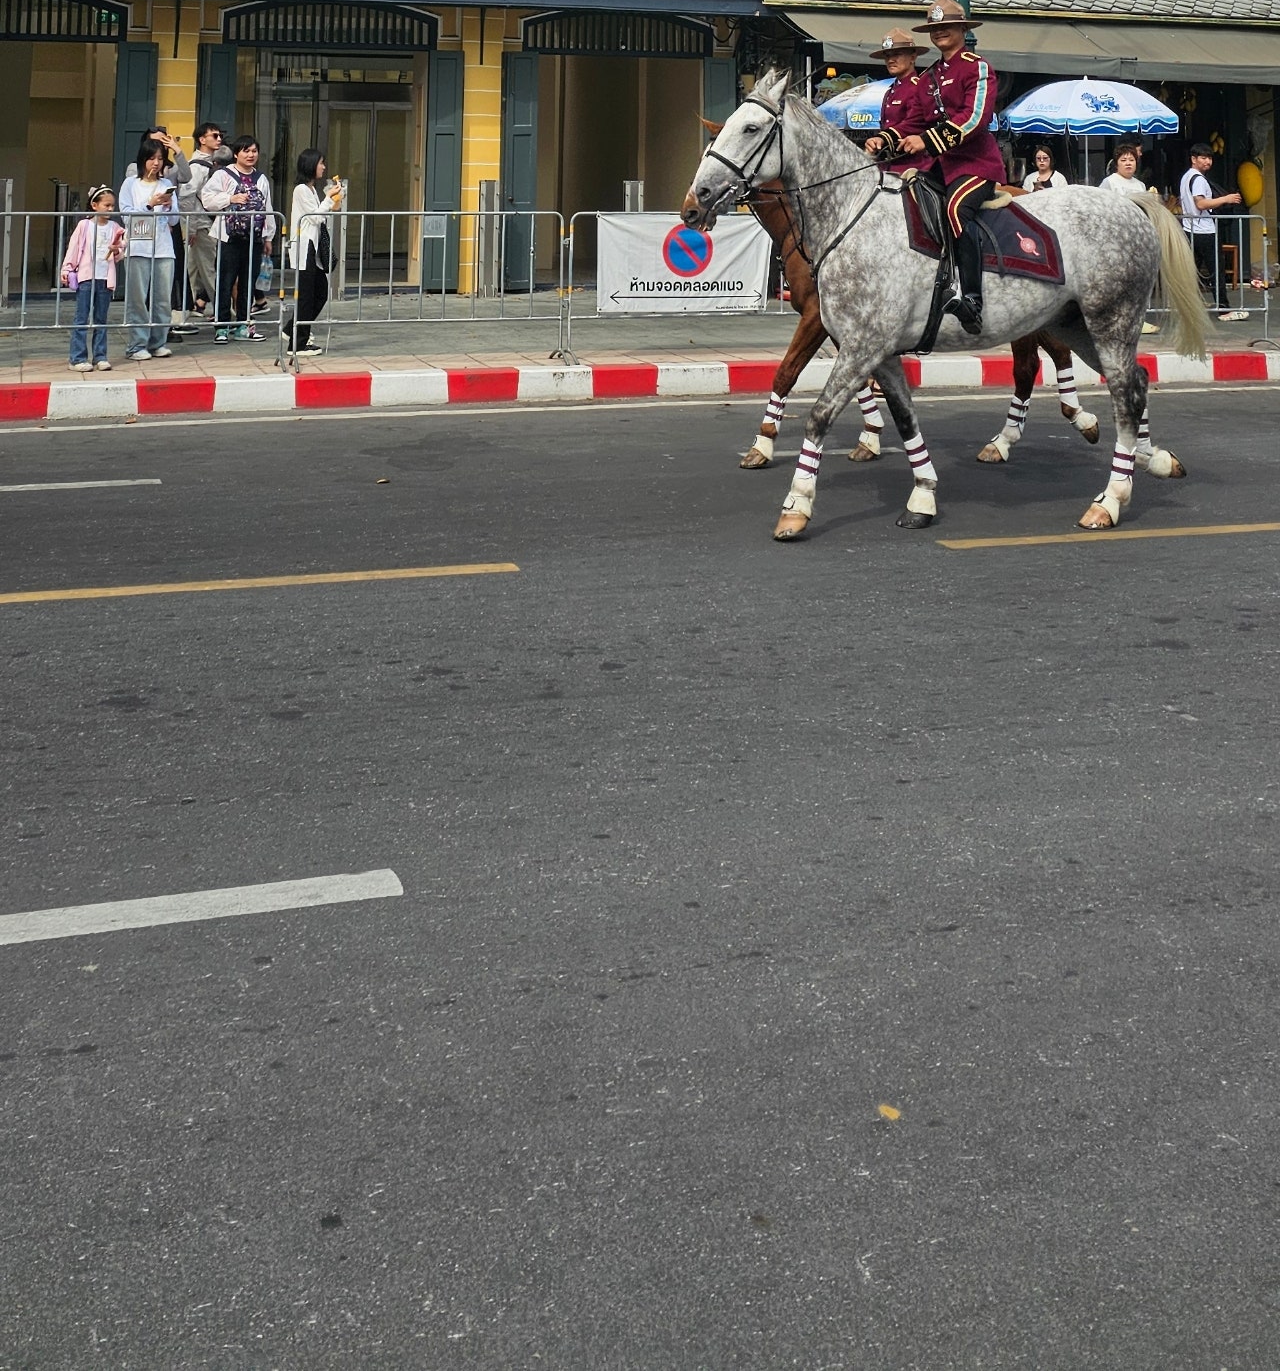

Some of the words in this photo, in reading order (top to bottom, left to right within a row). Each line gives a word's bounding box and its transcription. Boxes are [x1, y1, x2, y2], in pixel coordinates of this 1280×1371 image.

[630, 277, 743, 291] ห้ามจอดตลอดแนว
